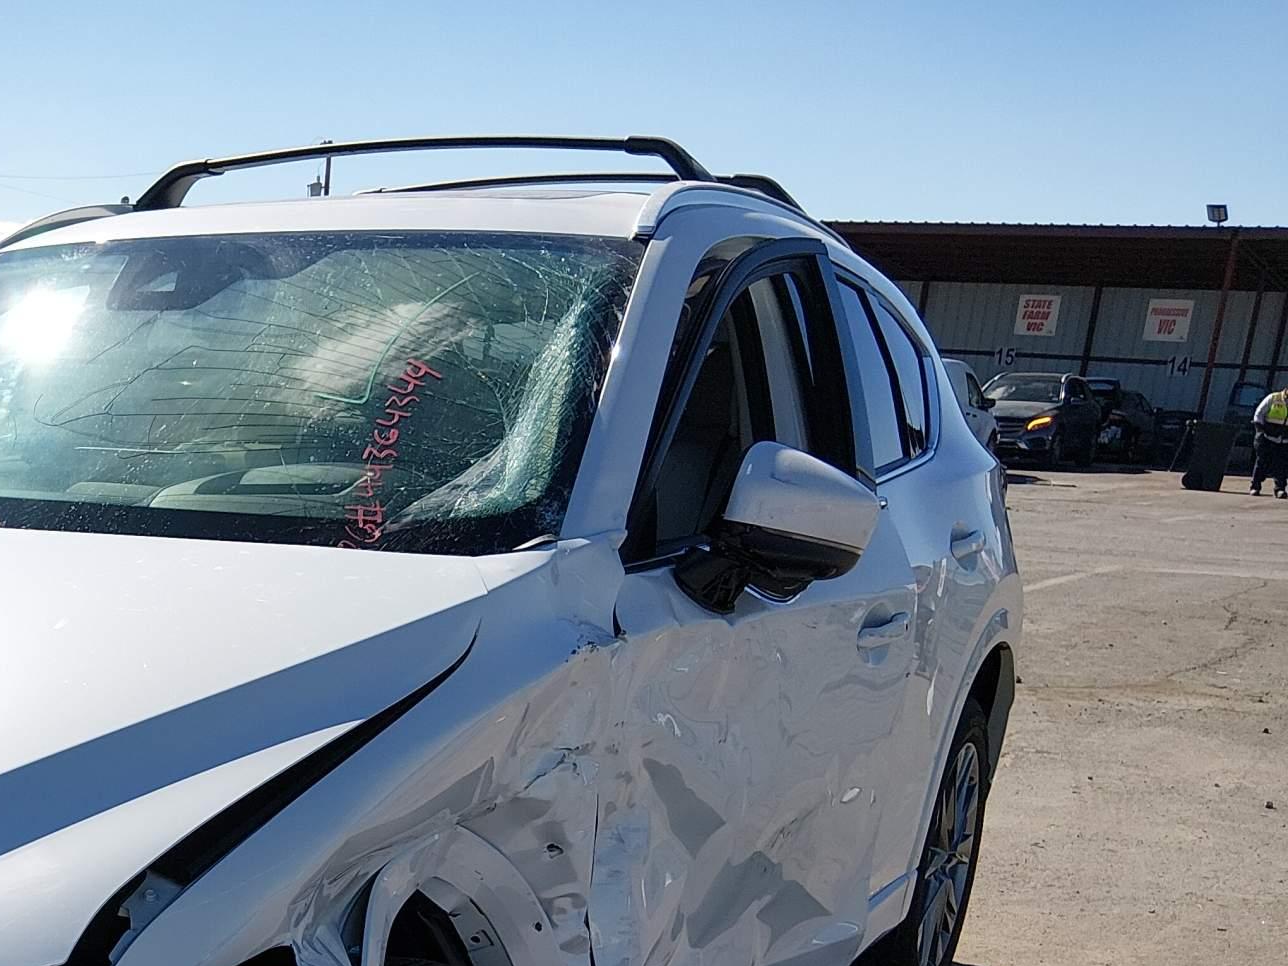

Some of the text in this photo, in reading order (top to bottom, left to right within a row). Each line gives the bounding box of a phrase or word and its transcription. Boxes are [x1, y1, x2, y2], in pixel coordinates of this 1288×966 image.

[1024, 299, 1053, 309] STATE
[1022, 310, 1052, 320] FARM
[1026, 321, 1044, 332] VIC
[1157, 319, 1177, 335] VIC
[996, 347, 1015, 365] 15
[1168, 356, 1188, 376] 14
